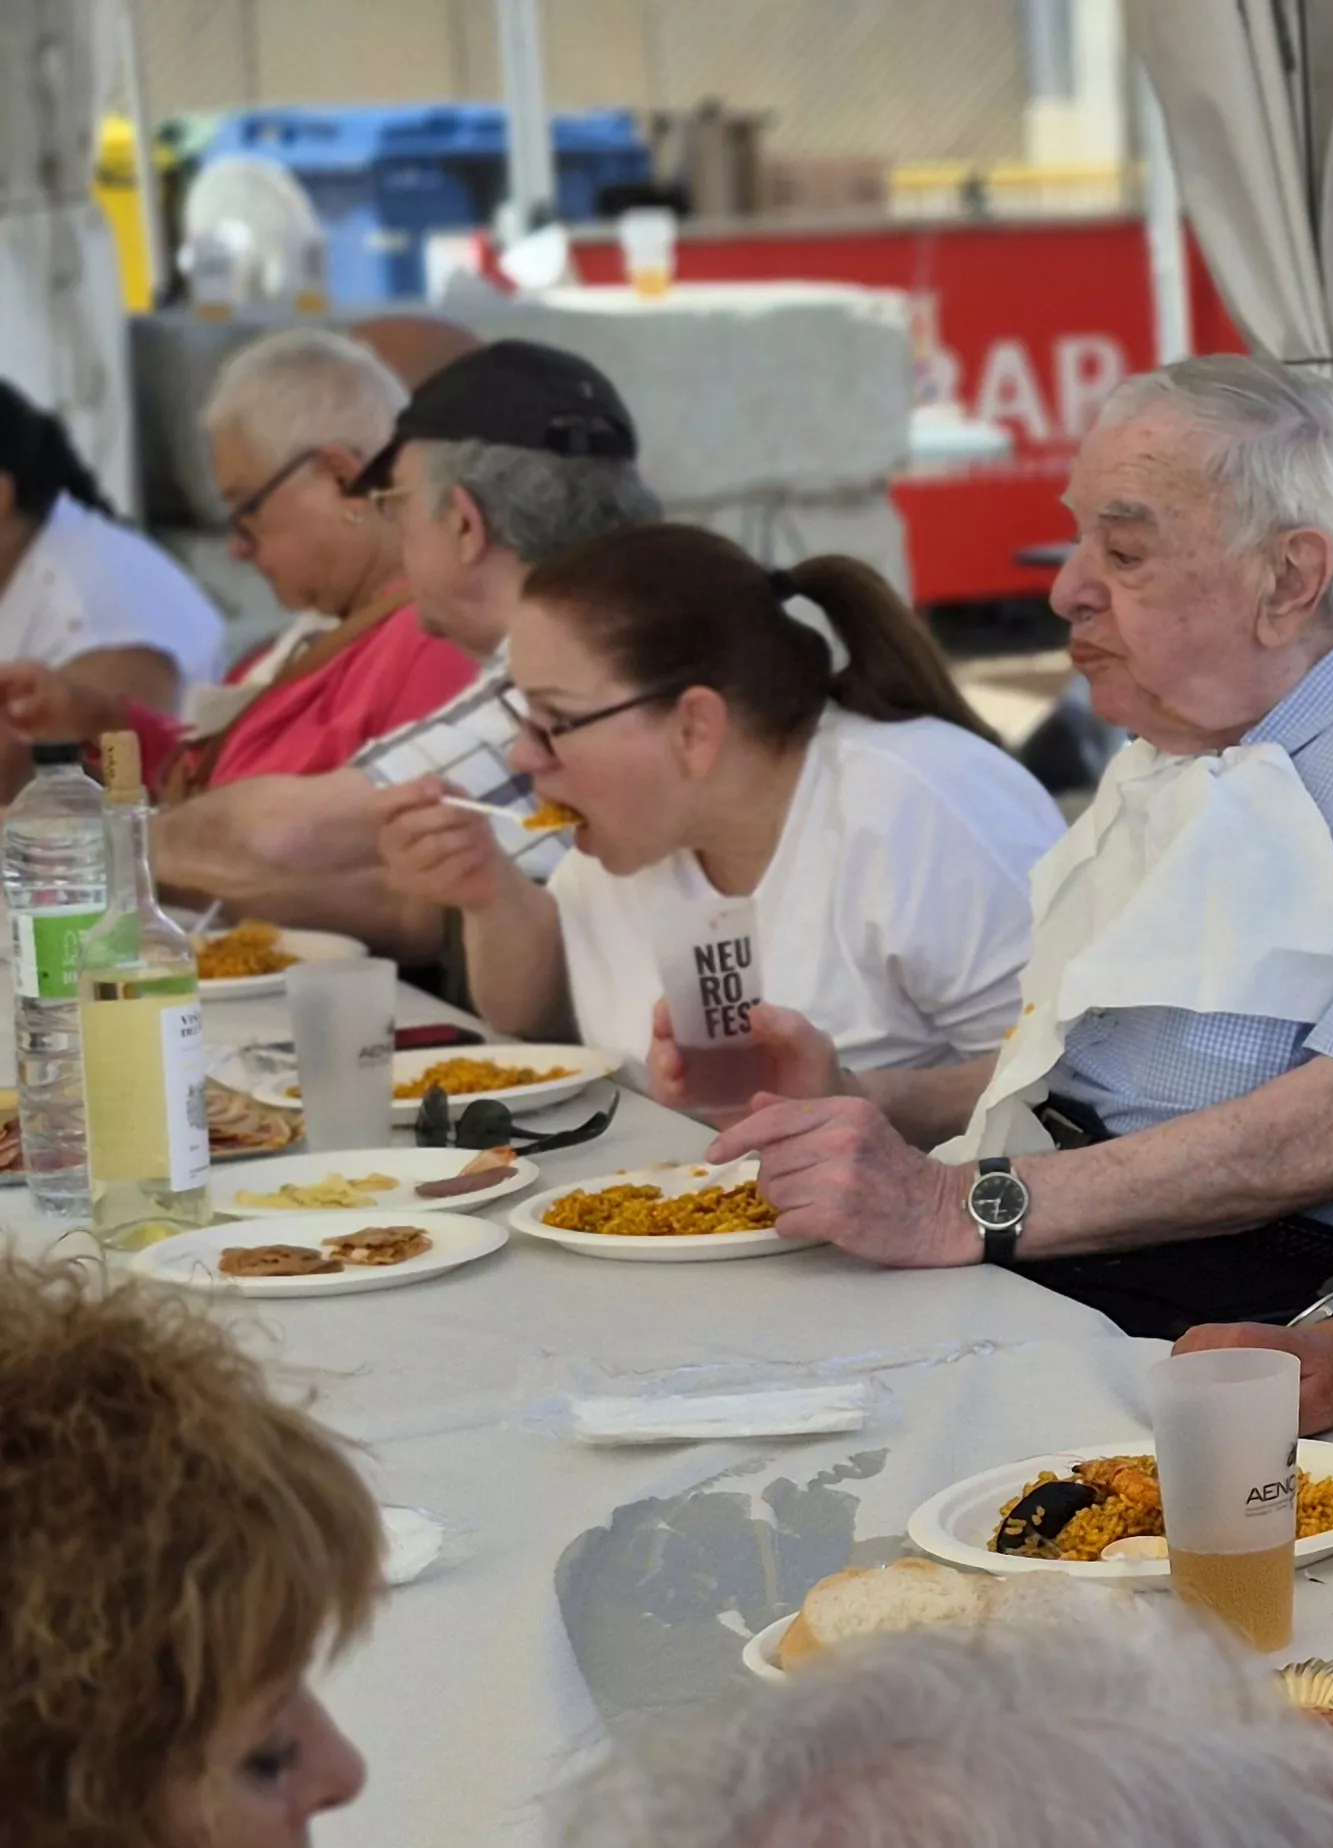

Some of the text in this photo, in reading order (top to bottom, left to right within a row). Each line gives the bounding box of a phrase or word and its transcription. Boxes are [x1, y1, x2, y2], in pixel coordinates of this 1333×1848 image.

[694, 936, 752, 975] NEU
[700, 971, 742, 1007] RO
[705, 998, 761, 1039] FES
